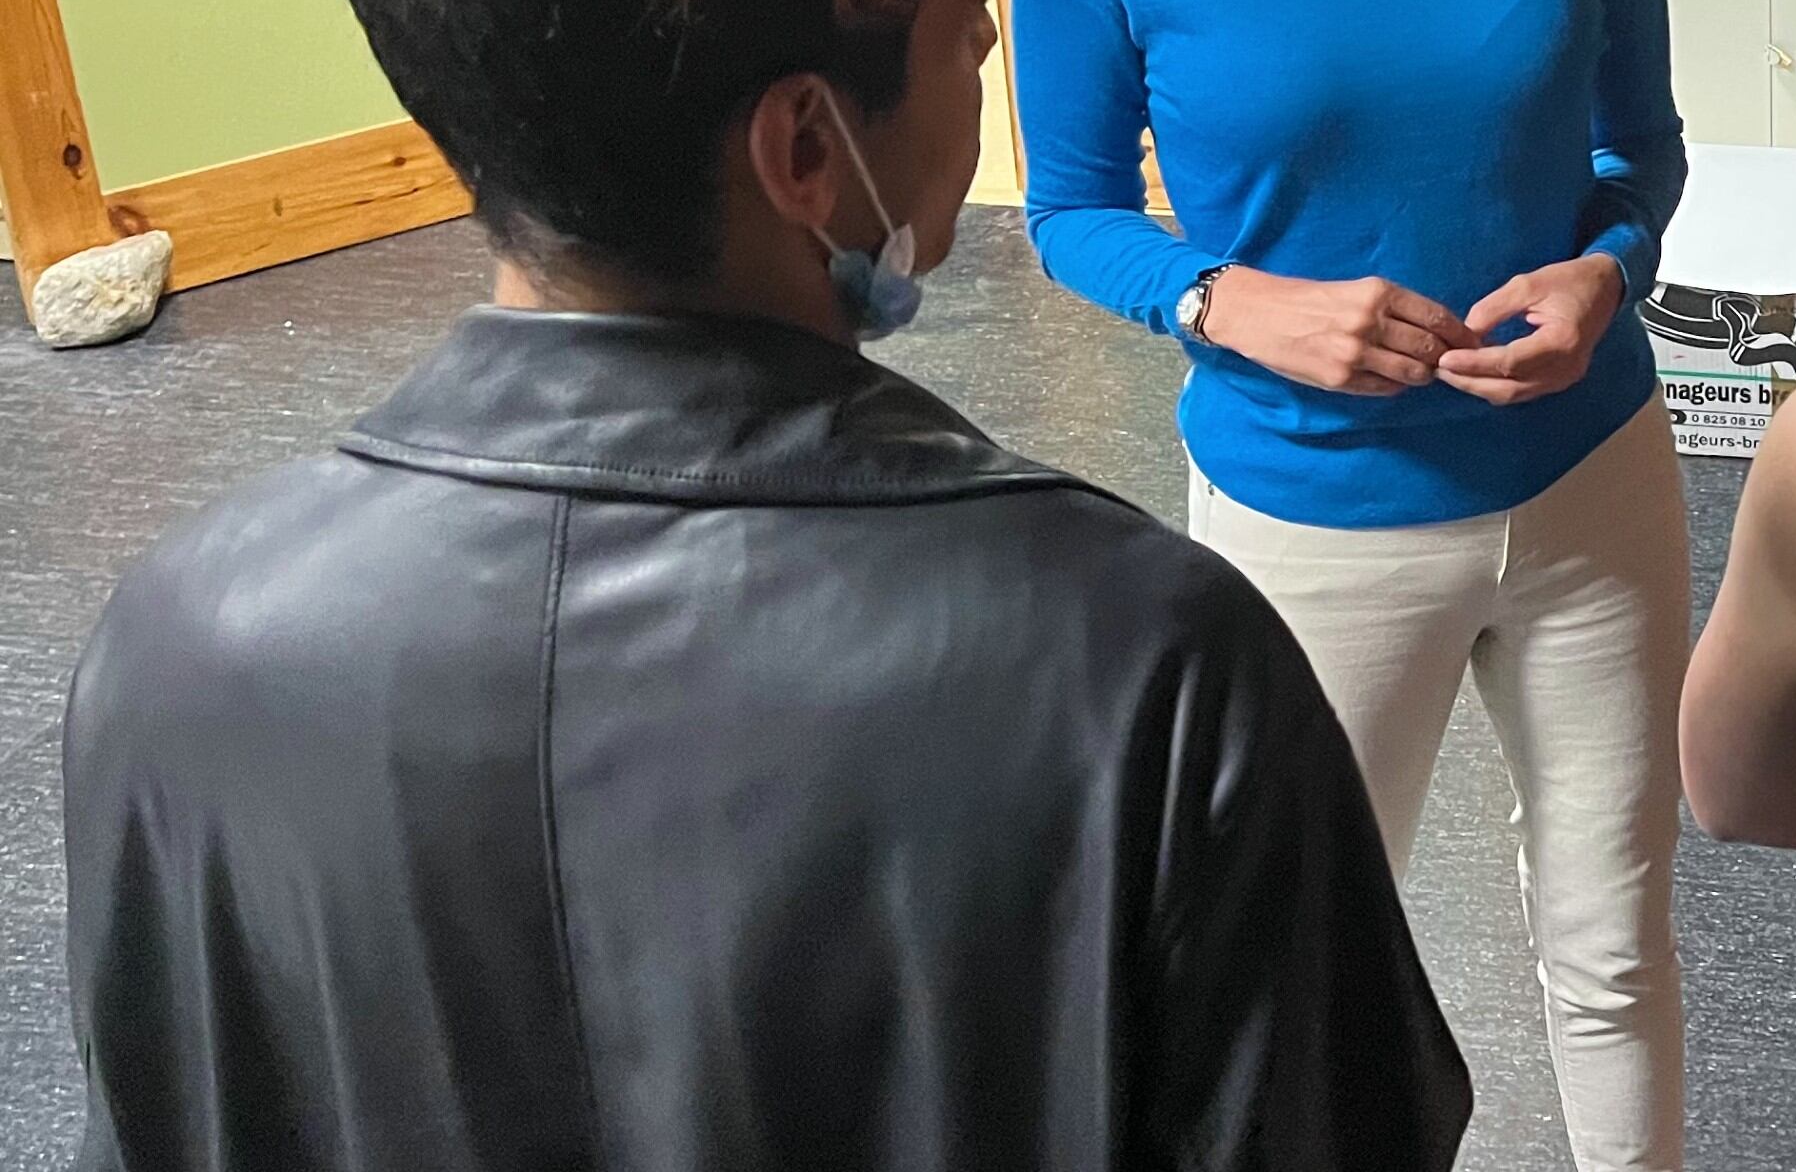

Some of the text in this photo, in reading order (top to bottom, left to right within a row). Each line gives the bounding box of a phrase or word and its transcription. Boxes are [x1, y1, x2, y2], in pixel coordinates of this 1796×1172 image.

[1665, 382, 1752, 405] nageurs
[1691, 413, 1766, 427] 0 825 08 10
